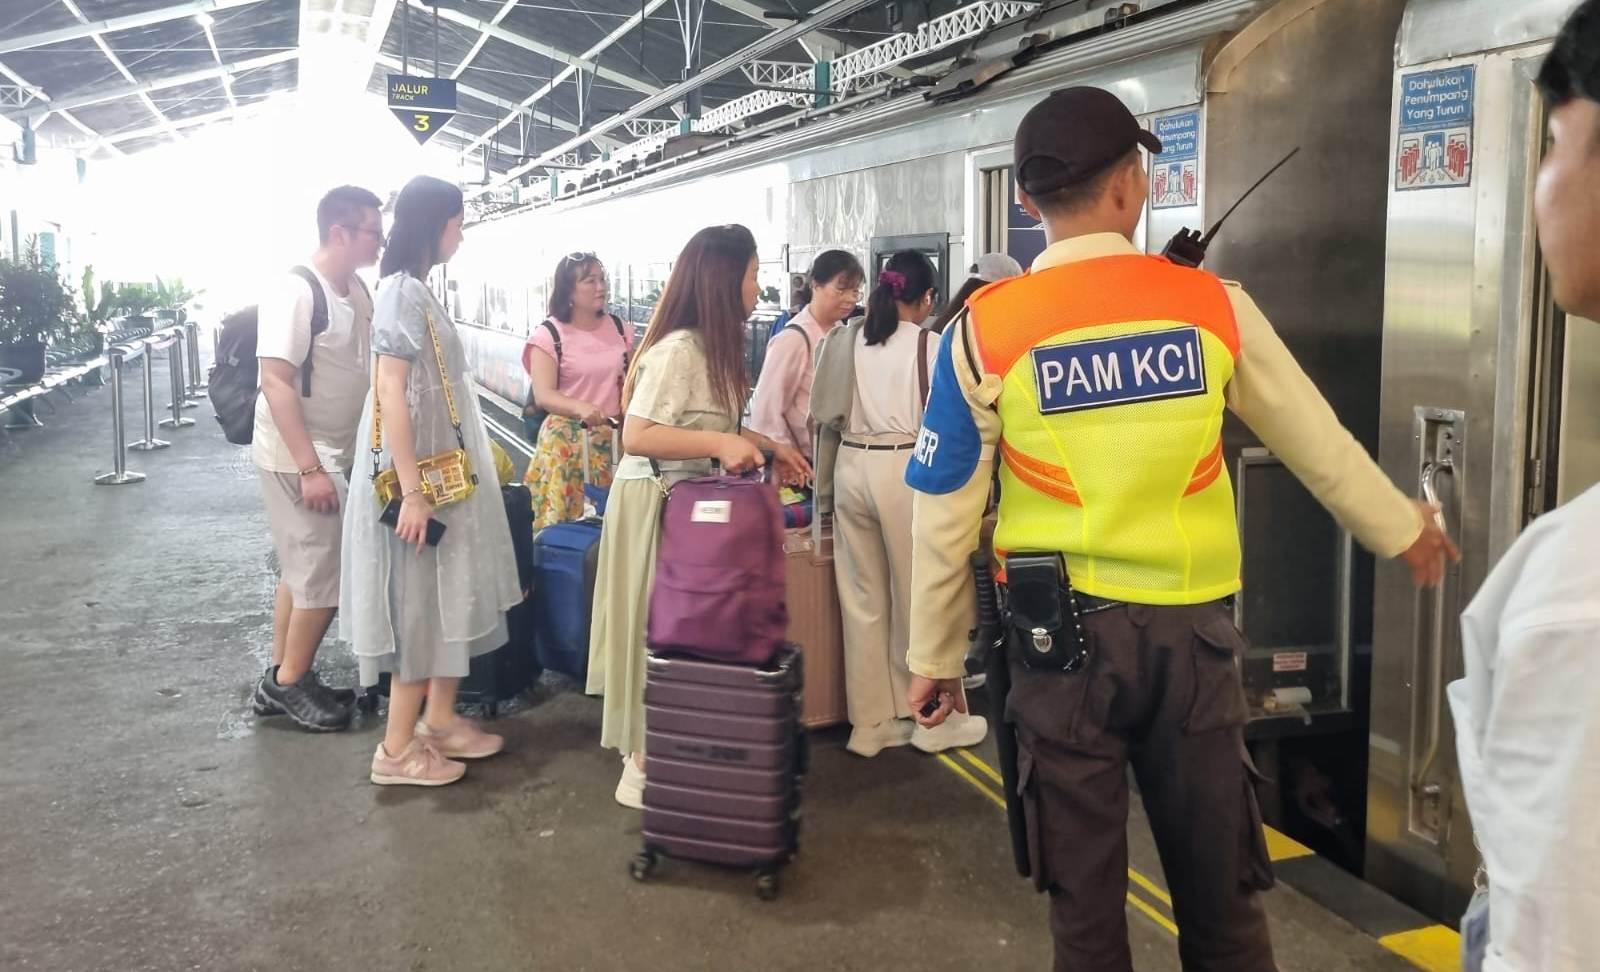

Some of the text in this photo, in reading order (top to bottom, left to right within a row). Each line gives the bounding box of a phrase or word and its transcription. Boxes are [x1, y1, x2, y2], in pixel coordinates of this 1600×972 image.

[392, 83, 428, 94] JALUR
[1409, 76, 1464, 90] Dahulukan
[1405, 90, 1468, 105] Penumpang
[1407, 105, 1464, 119] Yang Turun
[414, 114, 430, 132] 3
[1176, 143, 1192, 151] Turun
[1041, 341, 1196, 400] PAM KCI
